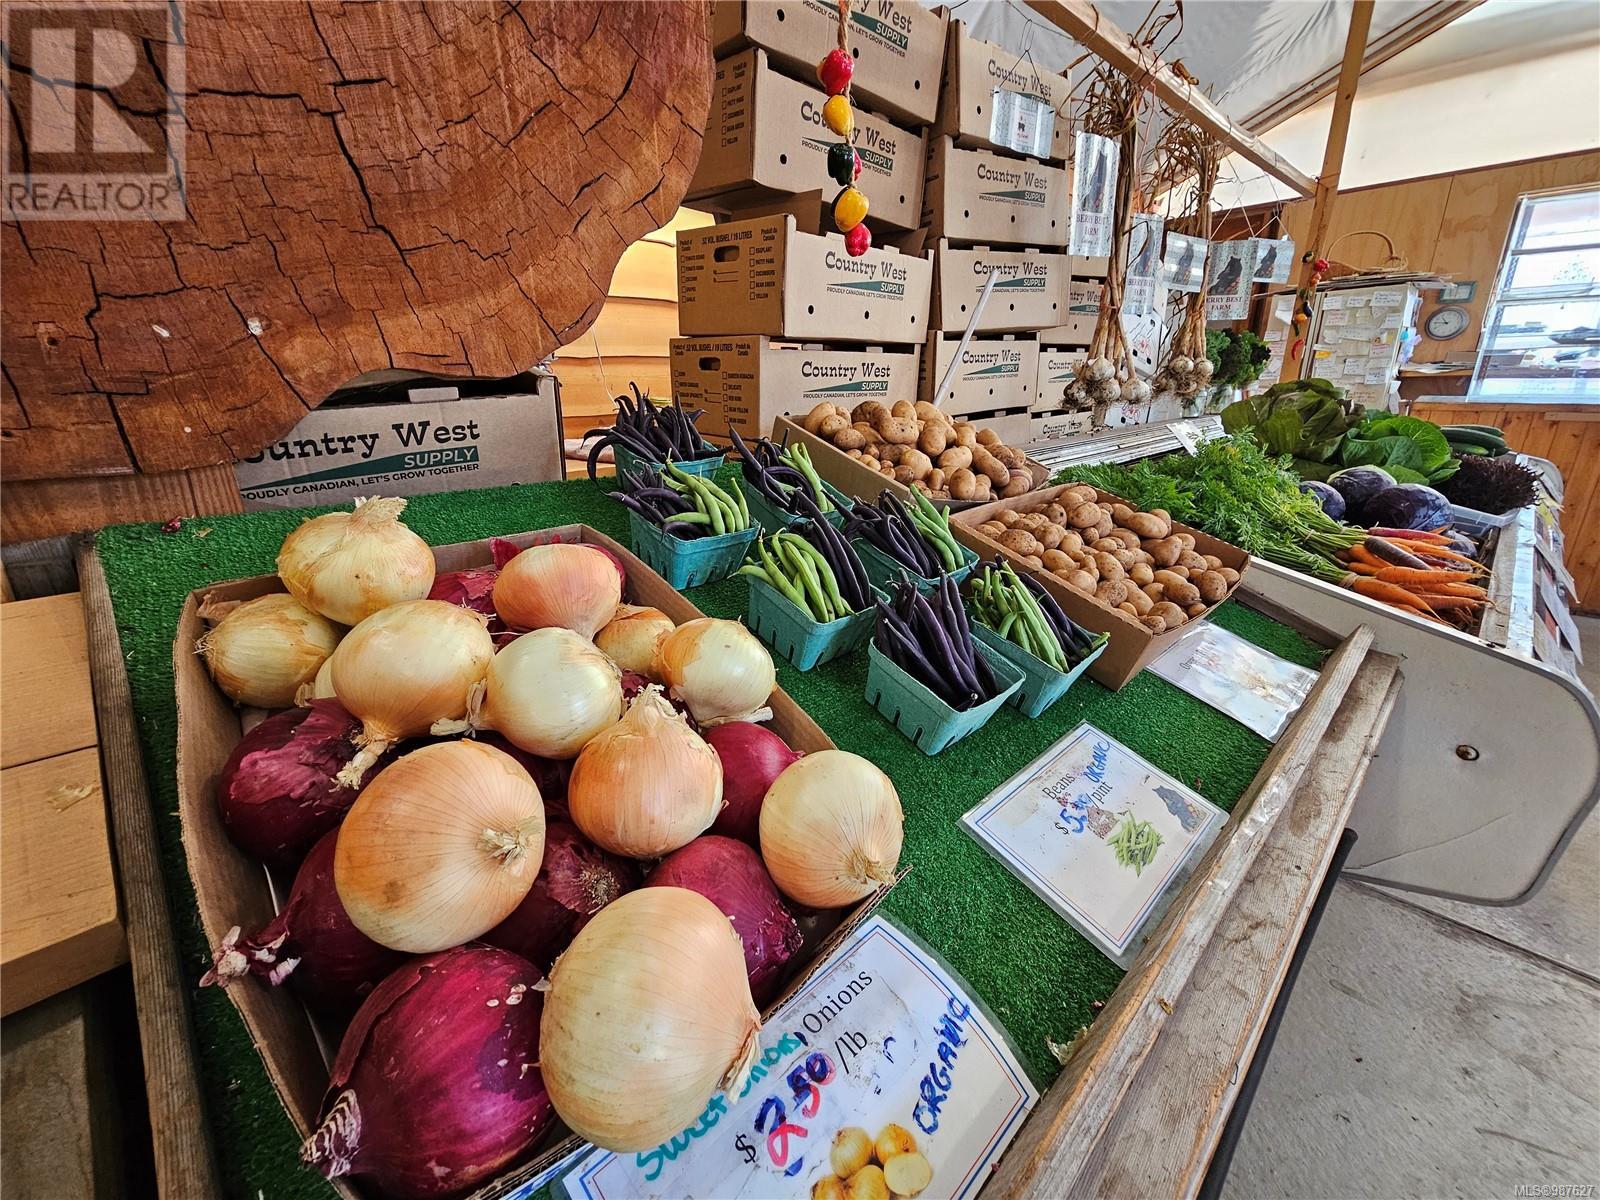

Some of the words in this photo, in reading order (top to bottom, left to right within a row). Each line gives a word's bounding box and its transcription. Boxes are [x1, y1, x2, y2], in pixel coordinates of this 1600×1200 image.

[802, 0, 828, 17] PROUDLY
[868, 33, 884, 46] GROW
[883, 41, 906, 58] TOGETHER
[875, 22, 908, 47] SUPPLY
[988, 59, 1028, 92] Country
[801, 139, 824, 154] PROUDLY
[865, 126, 897, 155] West
[865, 150, 893, 169] SUPPLY
[977, 163, 1021, 189] Country
[1024, 171, 1048, 190] West
[1024, 191, 1045, 202] SUPPLY
[738, 230, 753, 240] LITRES
[825, 250, 877, 280] Country
[880, 260, 907, 281] West
[973, 260, 1019, 279] Country
[1022, 261, 1048, 276] West
[826, 286, 846, 295] PROUDLY
[880, 282, 904, 294] SUPPLY
[1023, 278, 1045, 287] SUPPLY
[962, 350, 999, 366] Country
[1001, 349, 1022, 362] West
[801, 360, 857, 382] Country
[861, 362, 891, 378] West
[861, 381, 888, 391] SUPPLY
[244, 432, 380, 464] ountry
[391, 419, 481, 448] West
[404, 447, 476, 468] SUPPLY
[241, 487, 290, 500] OUDLY
[293, 479, 359, 494] CANADIAN,
[361, 473, 391, 486] LET'S
[392, 470, 426, 481] GROW
[428, 463, 480, 476] TOGETHER
[1042, 772, 1076, 800] Beans
[803, 969, 873, 1034] Onions
[912, 995, 971, 1136] ORGANIC
[636, 1094, 728, 1181] Sweet
[735, 1133, 757, 1164] $
